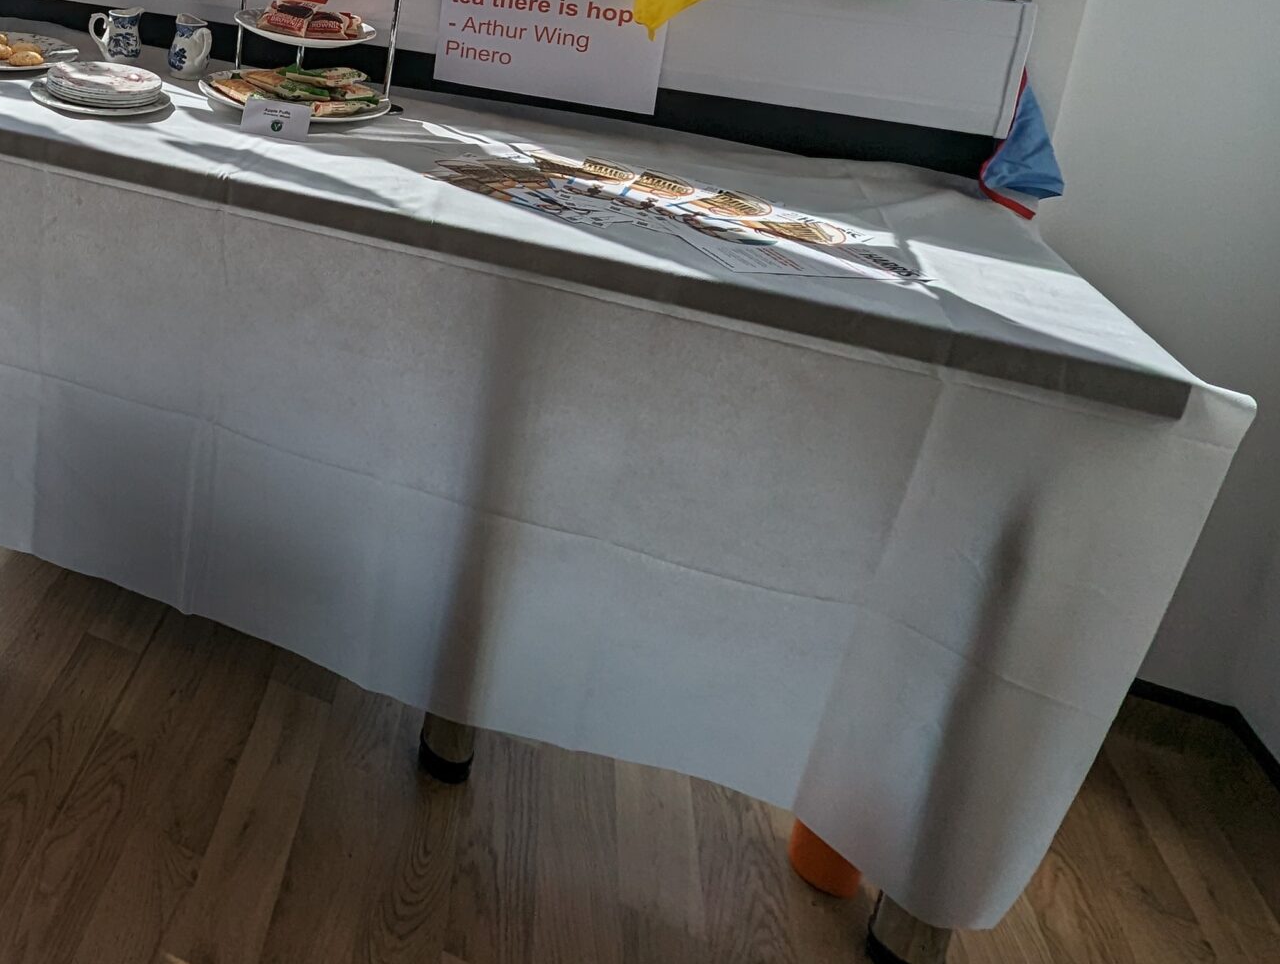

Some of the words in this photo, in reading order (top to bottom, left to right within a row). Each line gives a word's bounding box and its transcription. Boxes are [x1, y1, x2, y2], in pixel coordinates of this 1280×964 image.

[586, 1, 634, 27] hop
[460, 16, 527, 40] Arthur
[534, 25, 590, 53] Wing
[445, 40, 512, 66] Pinero
